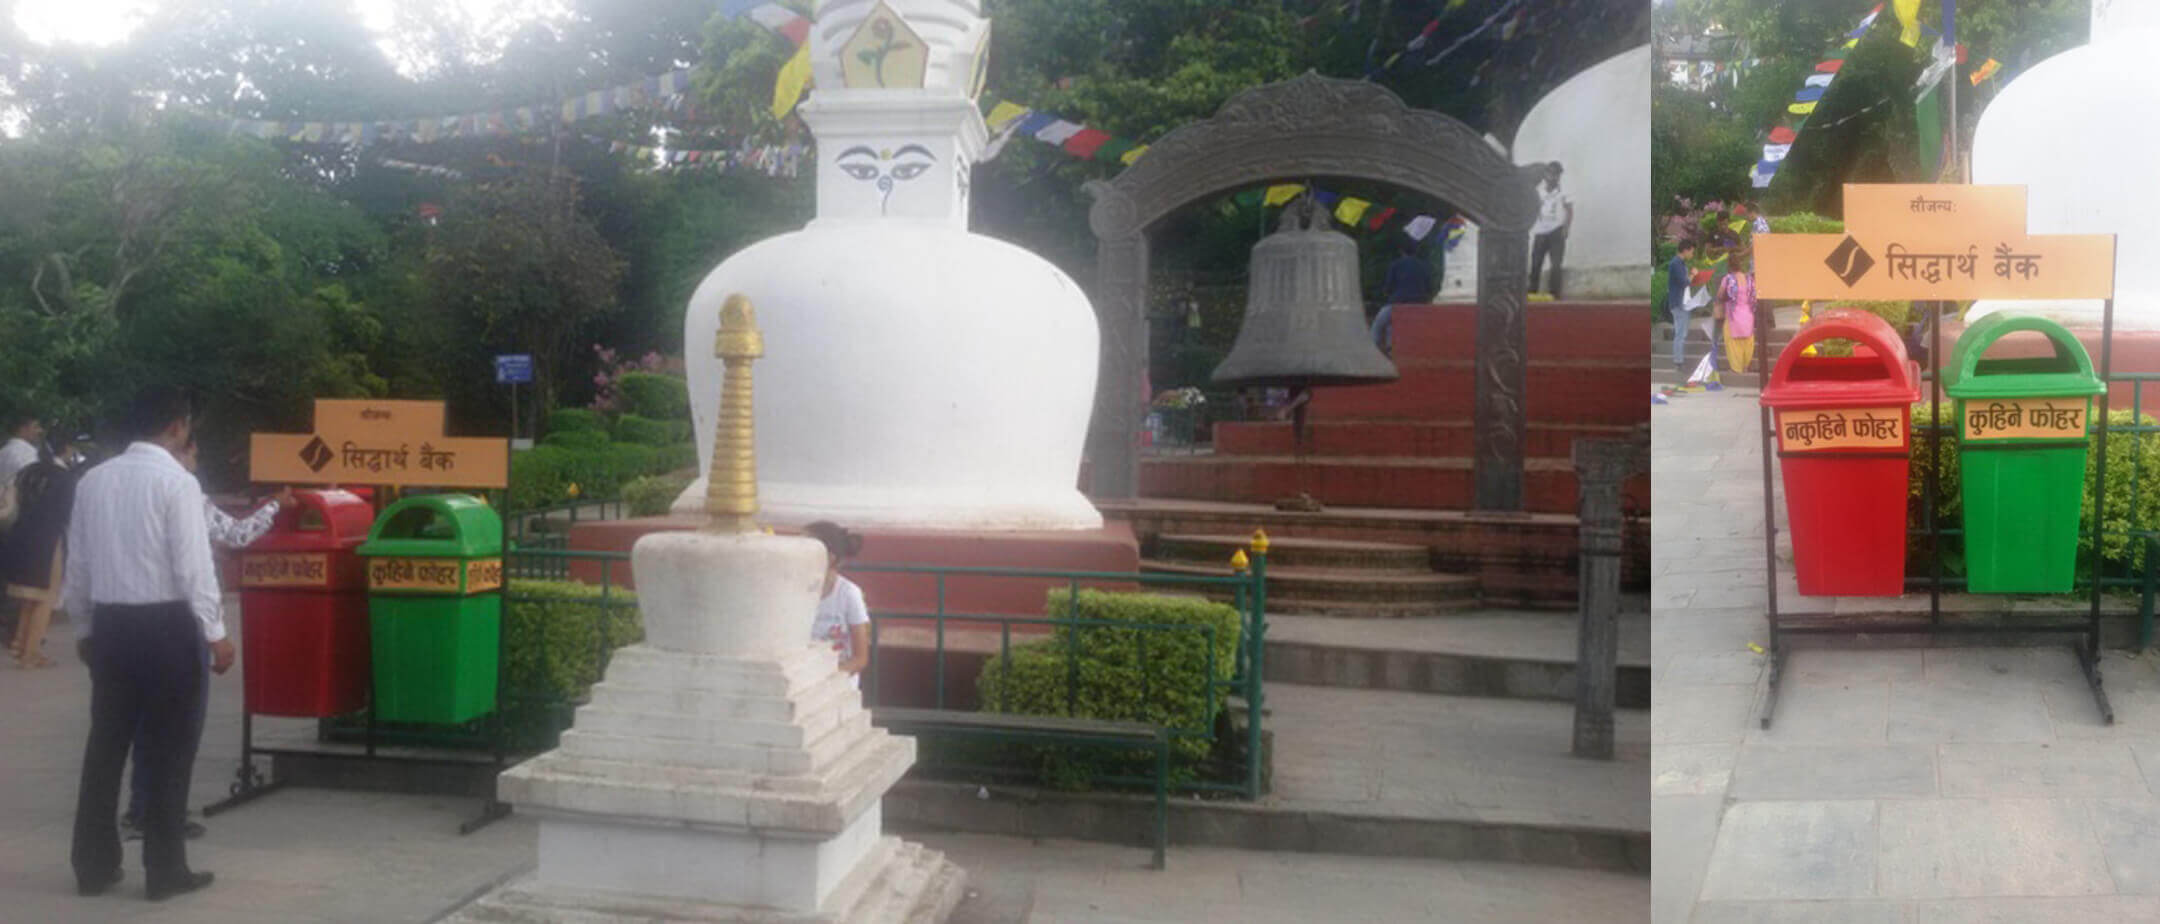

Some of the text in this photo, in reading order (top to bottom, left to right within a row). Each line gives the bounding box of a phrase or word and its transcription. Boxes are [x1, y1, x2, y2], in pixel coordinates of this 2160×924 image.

[1886, 242, 2042, 284] सिद्धार्थ बैंक
[1784, 412, 1899, 446] नकुहिने फोहर
[1969, 402, 2083, 435] कुहिने फोहर
